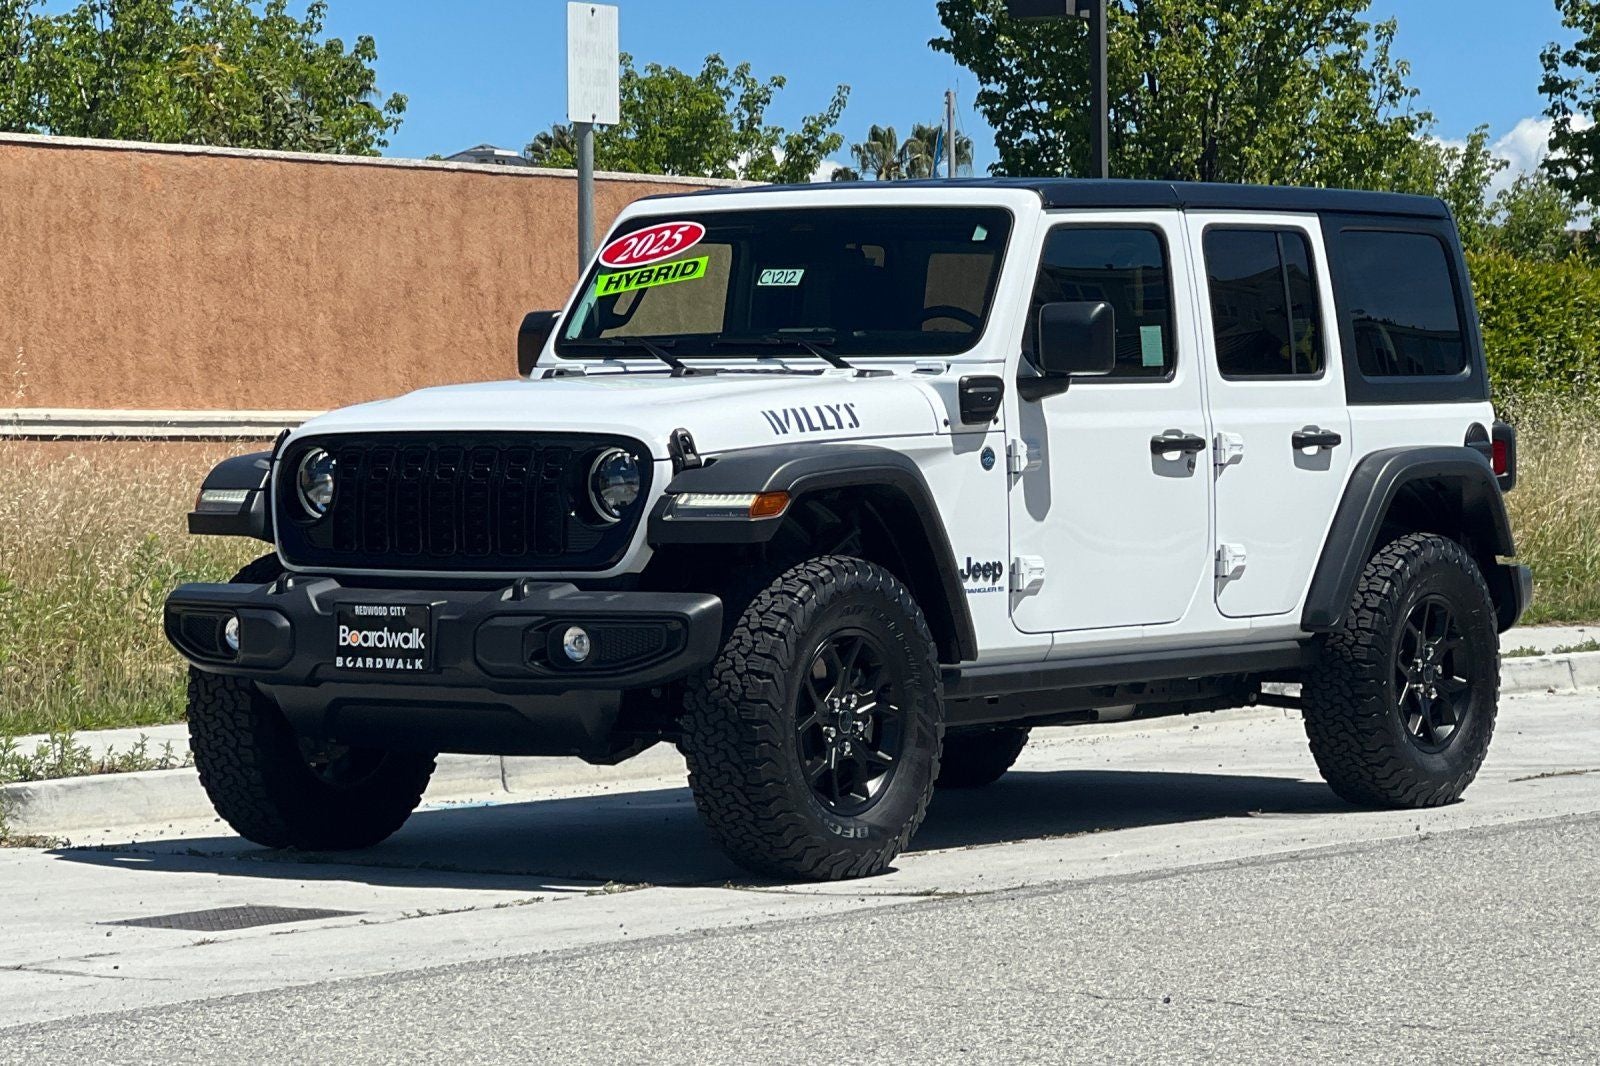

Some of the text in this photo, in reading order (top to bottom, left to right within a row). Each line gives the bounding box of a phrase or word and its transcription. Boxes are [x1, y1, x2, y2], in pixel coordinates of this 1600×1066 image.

[613, 225, 691, 263] 2025
[603, 260, 700, 292] HYBRID
[759, 270, 797, 285] C1212
[760, 402, 860, 435] WILLYS
[960, 556, 1003, 583] Jeep
[354, 605, 407, 616] REDWOOD CITY
[338, 624, 426, 650] Boardwalk
[335, 656, 424, 670] BOARDWALK
